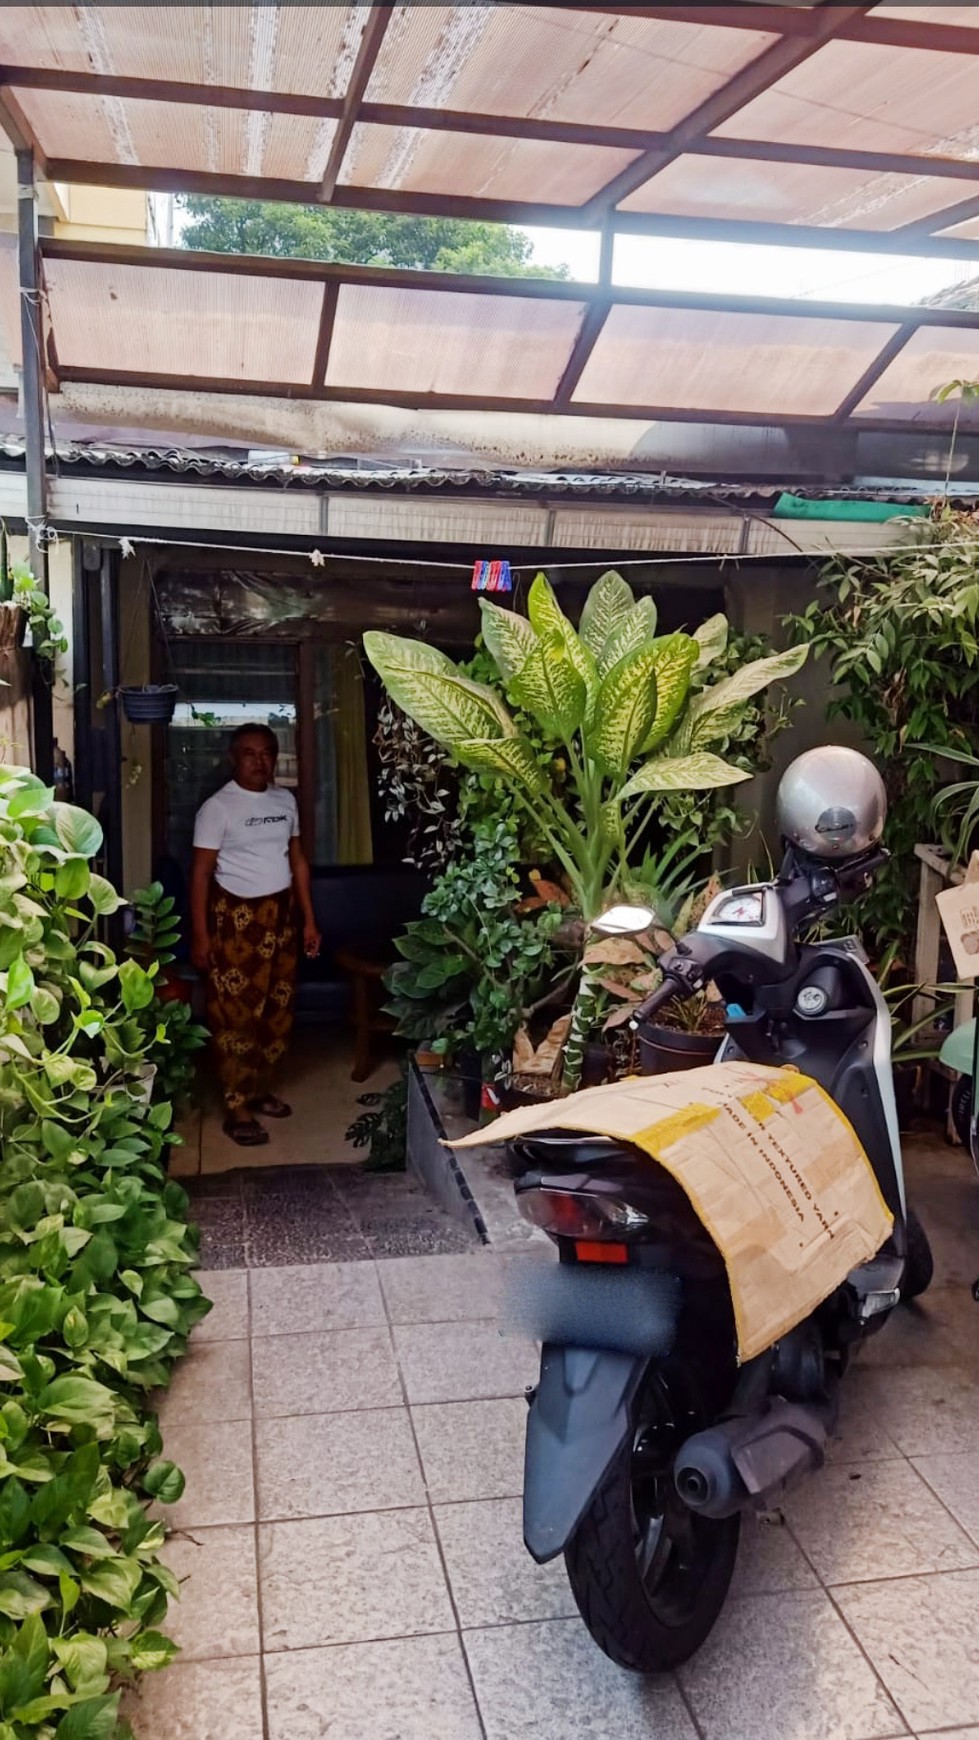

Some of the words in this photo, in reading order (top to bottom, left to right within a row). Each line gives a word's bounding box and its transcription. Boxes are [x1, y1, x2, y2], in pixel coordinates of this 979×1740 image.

[747, 1133, 758, 1146] IN
[759, 1149, 804, 1222] INDONESIA
[768, 1134, 812, 1200] TEXTURED
[813, 1204, 835, 1239] YARN
